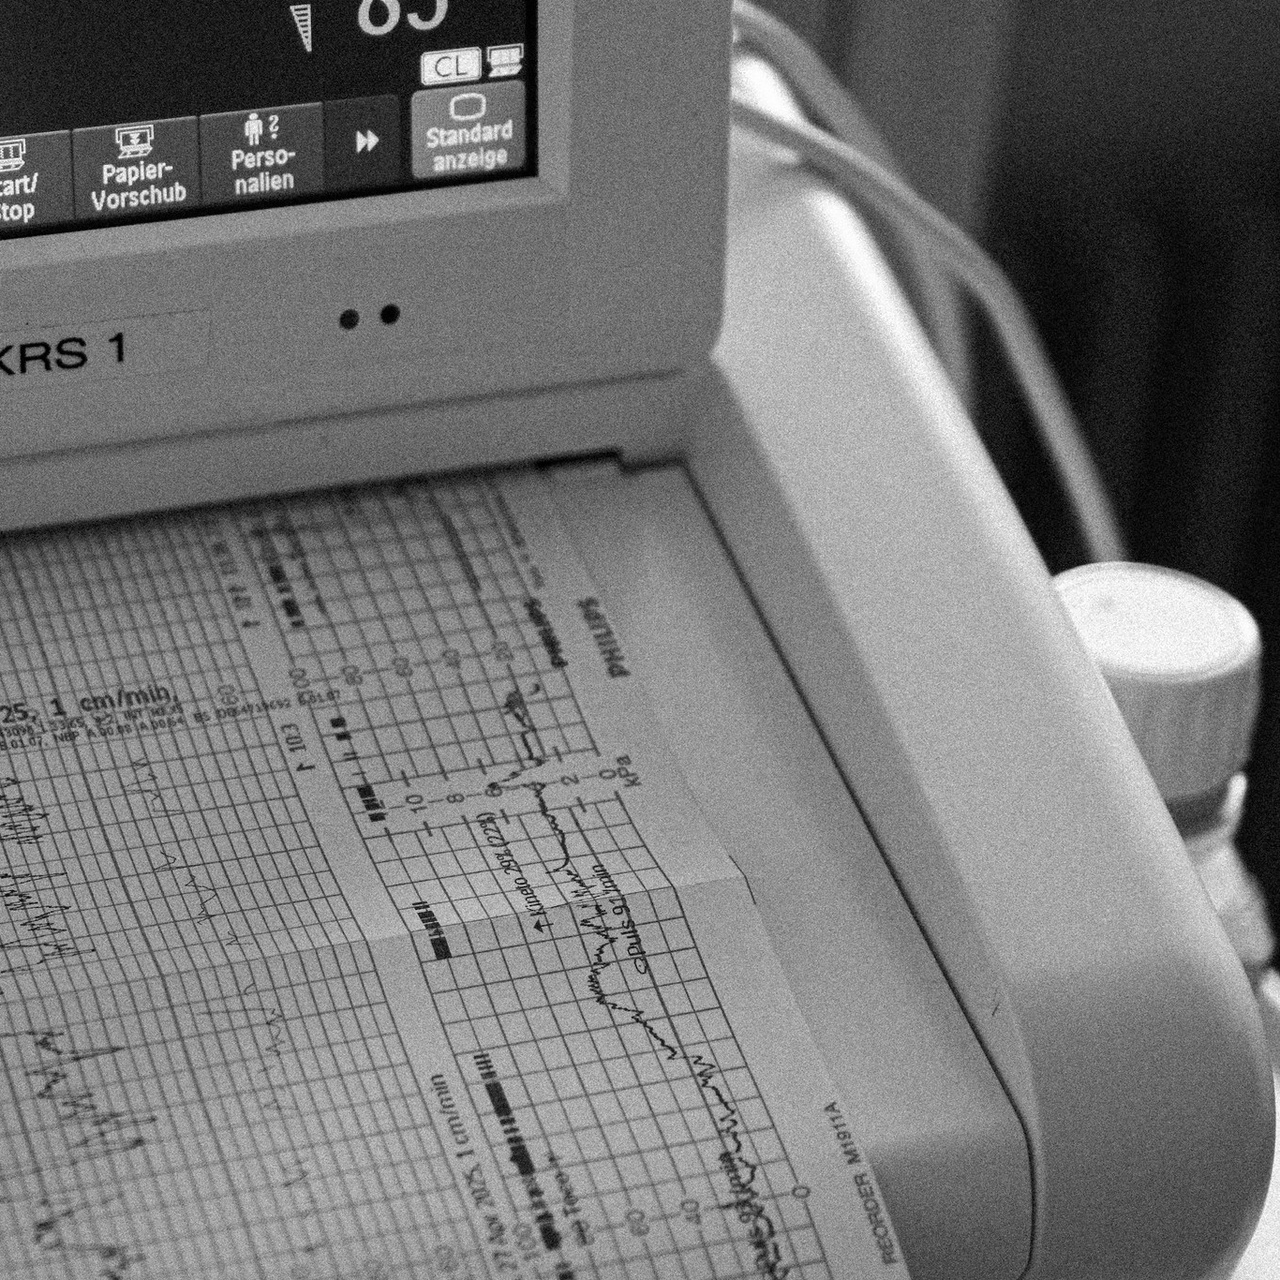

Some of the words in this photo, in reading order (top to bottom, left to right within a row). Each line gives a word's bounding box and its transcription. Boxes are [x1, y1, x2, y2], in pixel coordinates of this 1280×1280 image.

[434, 54, 468, 78] CL
[426, 119, 514, 150] Standard
[102, 161, 174, 187] Papier-
[231, 147, 296, 171] Perso-
[433, 147, 508, 173] anzeige
[91, 183, 187, 212] Vorschub
[235, 171, 294, 196] nalien
[108, 332, 124, 362] 1
[577, 597, 631, 678] PHILIPS
[51, 697, 67, 719] 1
[616, 755, 642, 788] kPa
[515, 877, 547, 916] Kineto
[621, 918, 646, 956] Puls
[824, 1101, 862, 1166] M1911A
[853, 1172, 898, 1266] REORDER
